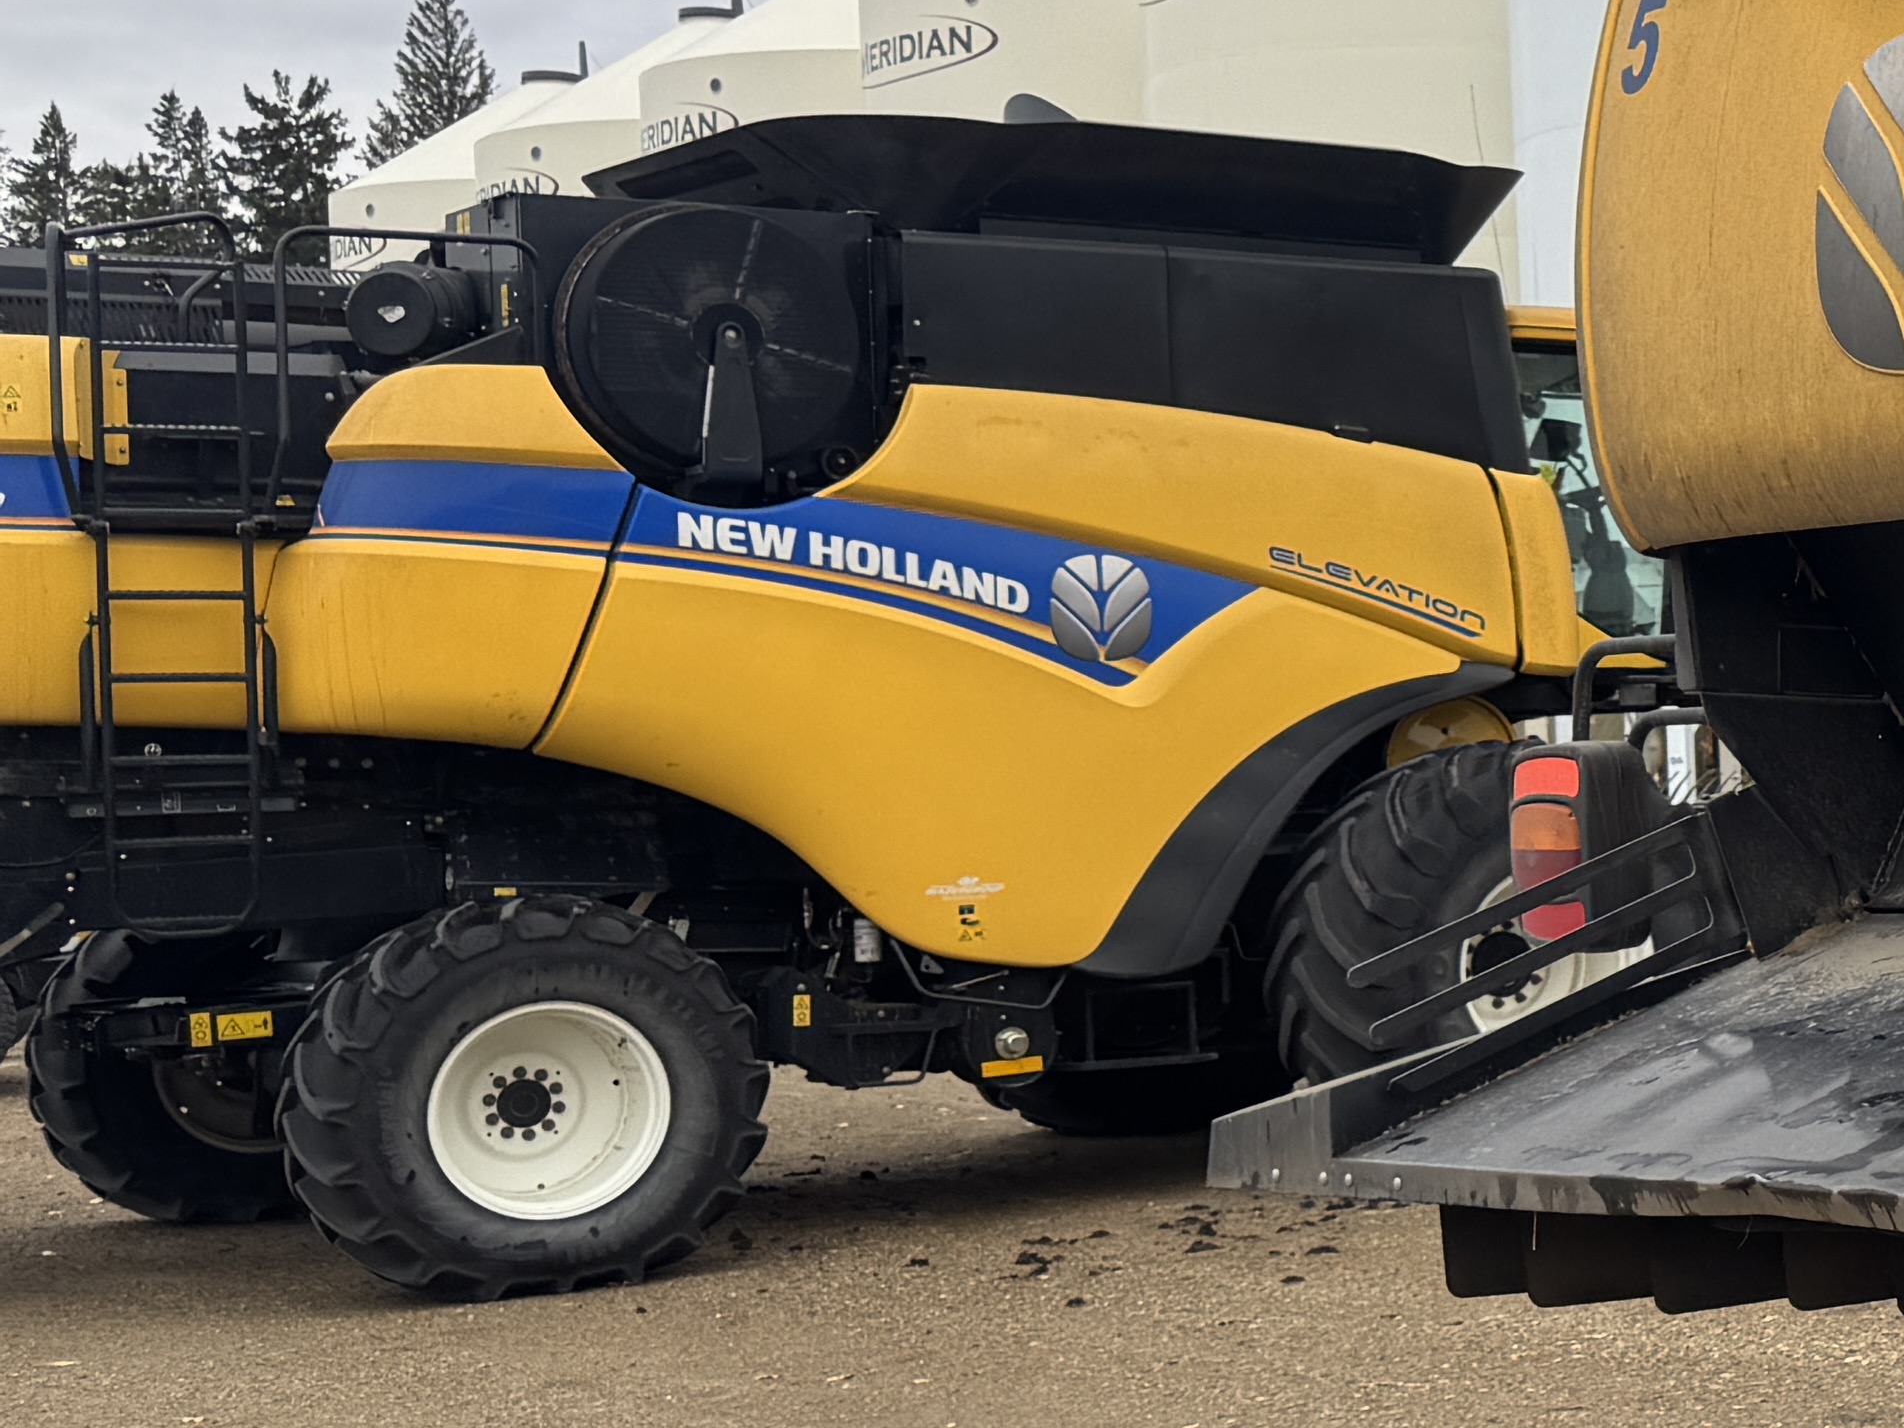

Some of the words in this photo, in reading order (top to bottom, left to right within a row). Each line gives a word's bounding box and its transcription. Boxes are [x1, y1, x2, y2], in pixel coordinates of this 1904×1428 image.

[677, 511, 798, 562] NEW
[809, 529, 1030, 615] HOLLAND
[1269, 546, 1486, 631] ELEVATION
